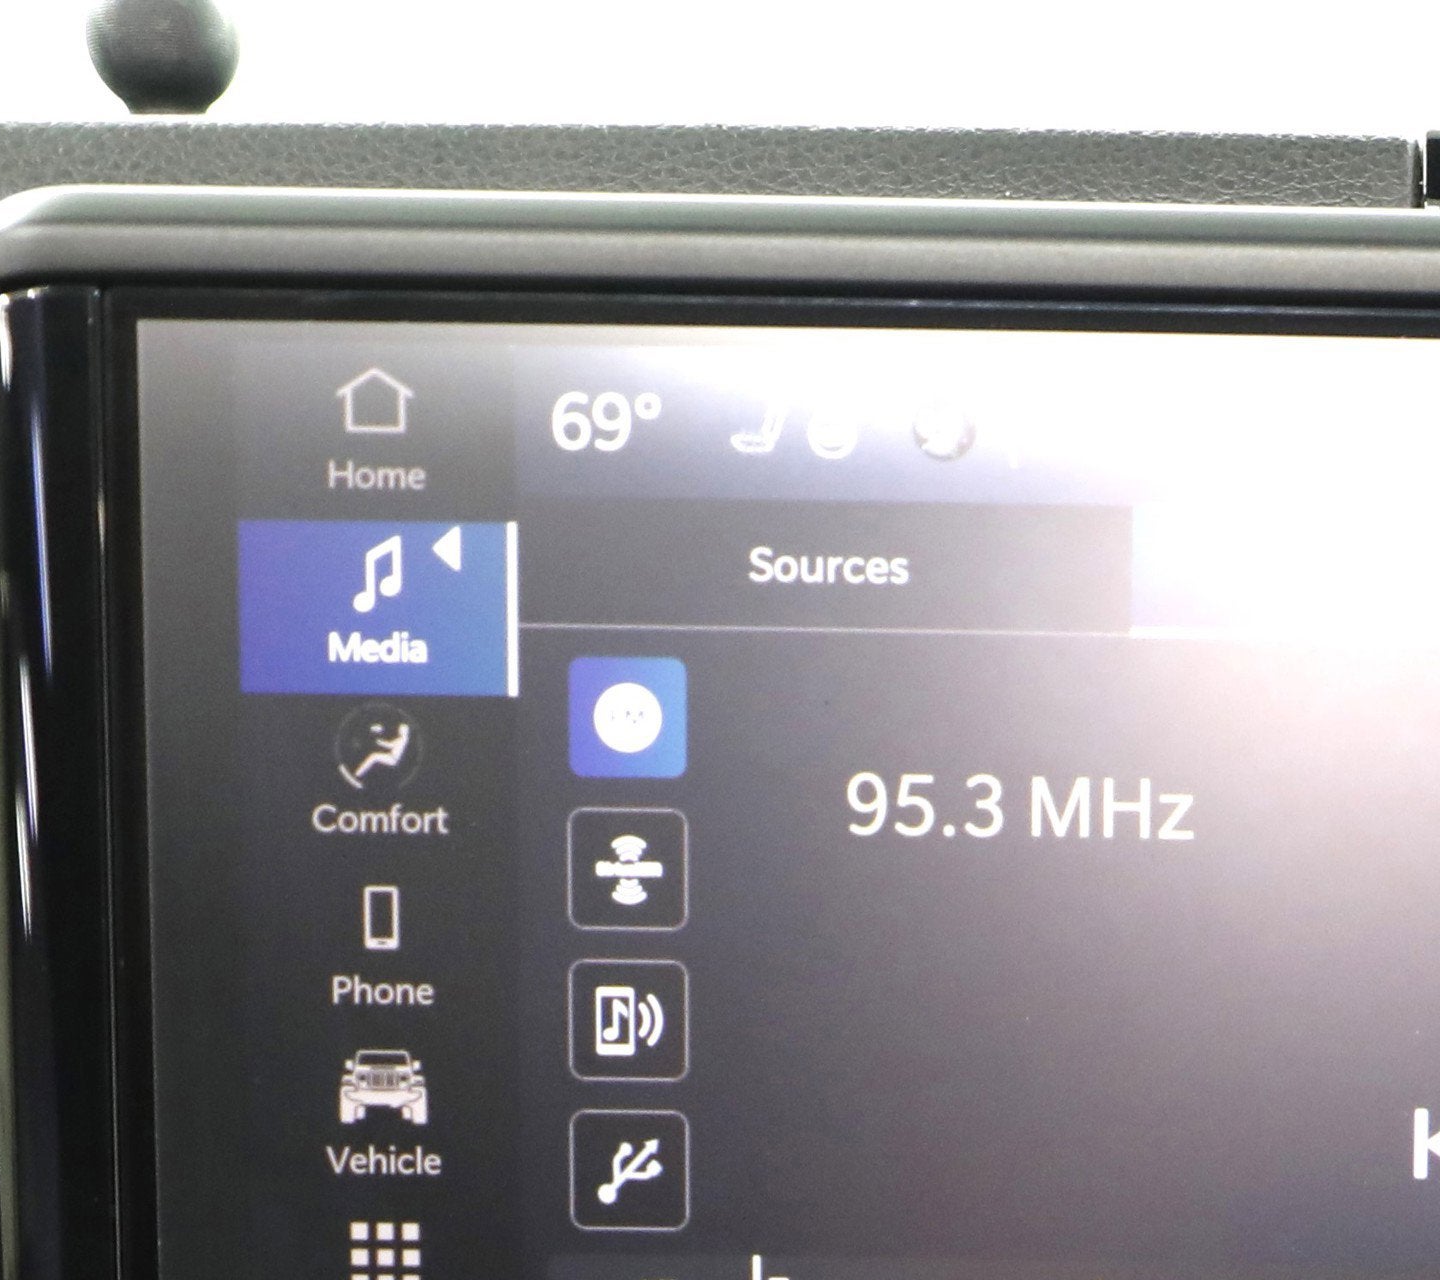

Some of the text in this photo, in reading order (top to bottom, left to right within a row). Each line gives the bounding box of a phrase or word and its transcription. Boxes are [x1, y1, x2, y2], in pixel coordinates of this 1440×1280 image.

[549, 391, 663, 452] 69°
[327, 460, 427, 492] Home
[747, 546, 910, 587] Sources
[327, 633, 428, 665] Media
[312, 803, 449, 837] Comfort
[846, 772, 1196, 842] 95.3 MHz
[331, 974, 434, 1007] Phone
[326, 1146, 442, 1177] Vehicle
